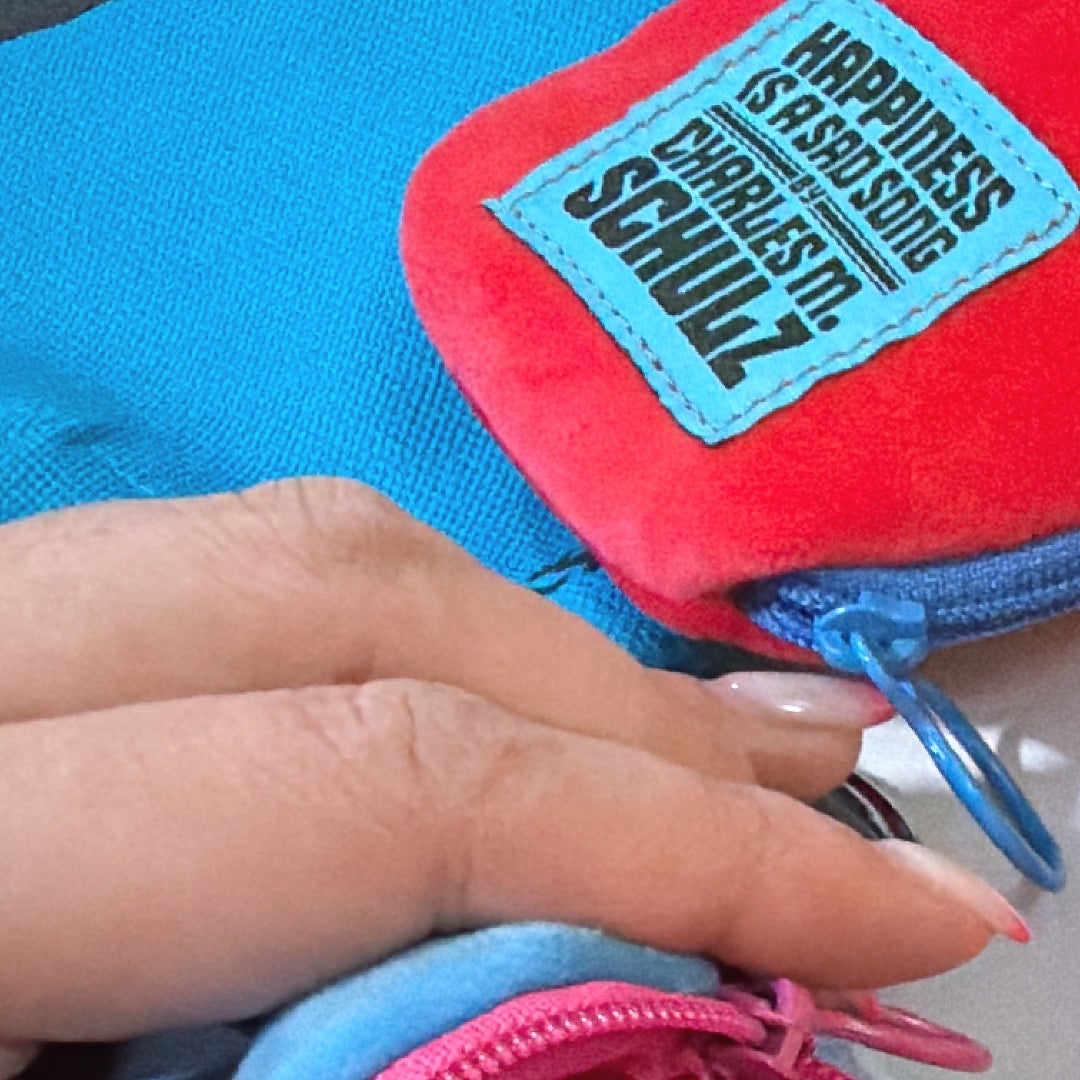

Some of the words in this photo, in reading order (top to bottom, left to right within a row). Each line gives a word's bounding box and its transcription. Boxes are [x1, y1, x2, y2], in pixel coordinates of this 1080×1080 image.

[651, 117, 826, 275] CHARLES
[785, 257, 862, 331] M.
[736, 68, 797, 114] IS
[767, 95, 817, 134] A
[797, 117, 881, 188] SAD
[849, 169, 958, 273] SONG
[782, 21, 1015, 232] HAPPINESS
[564, 156, 812, 389] SCHULZ
